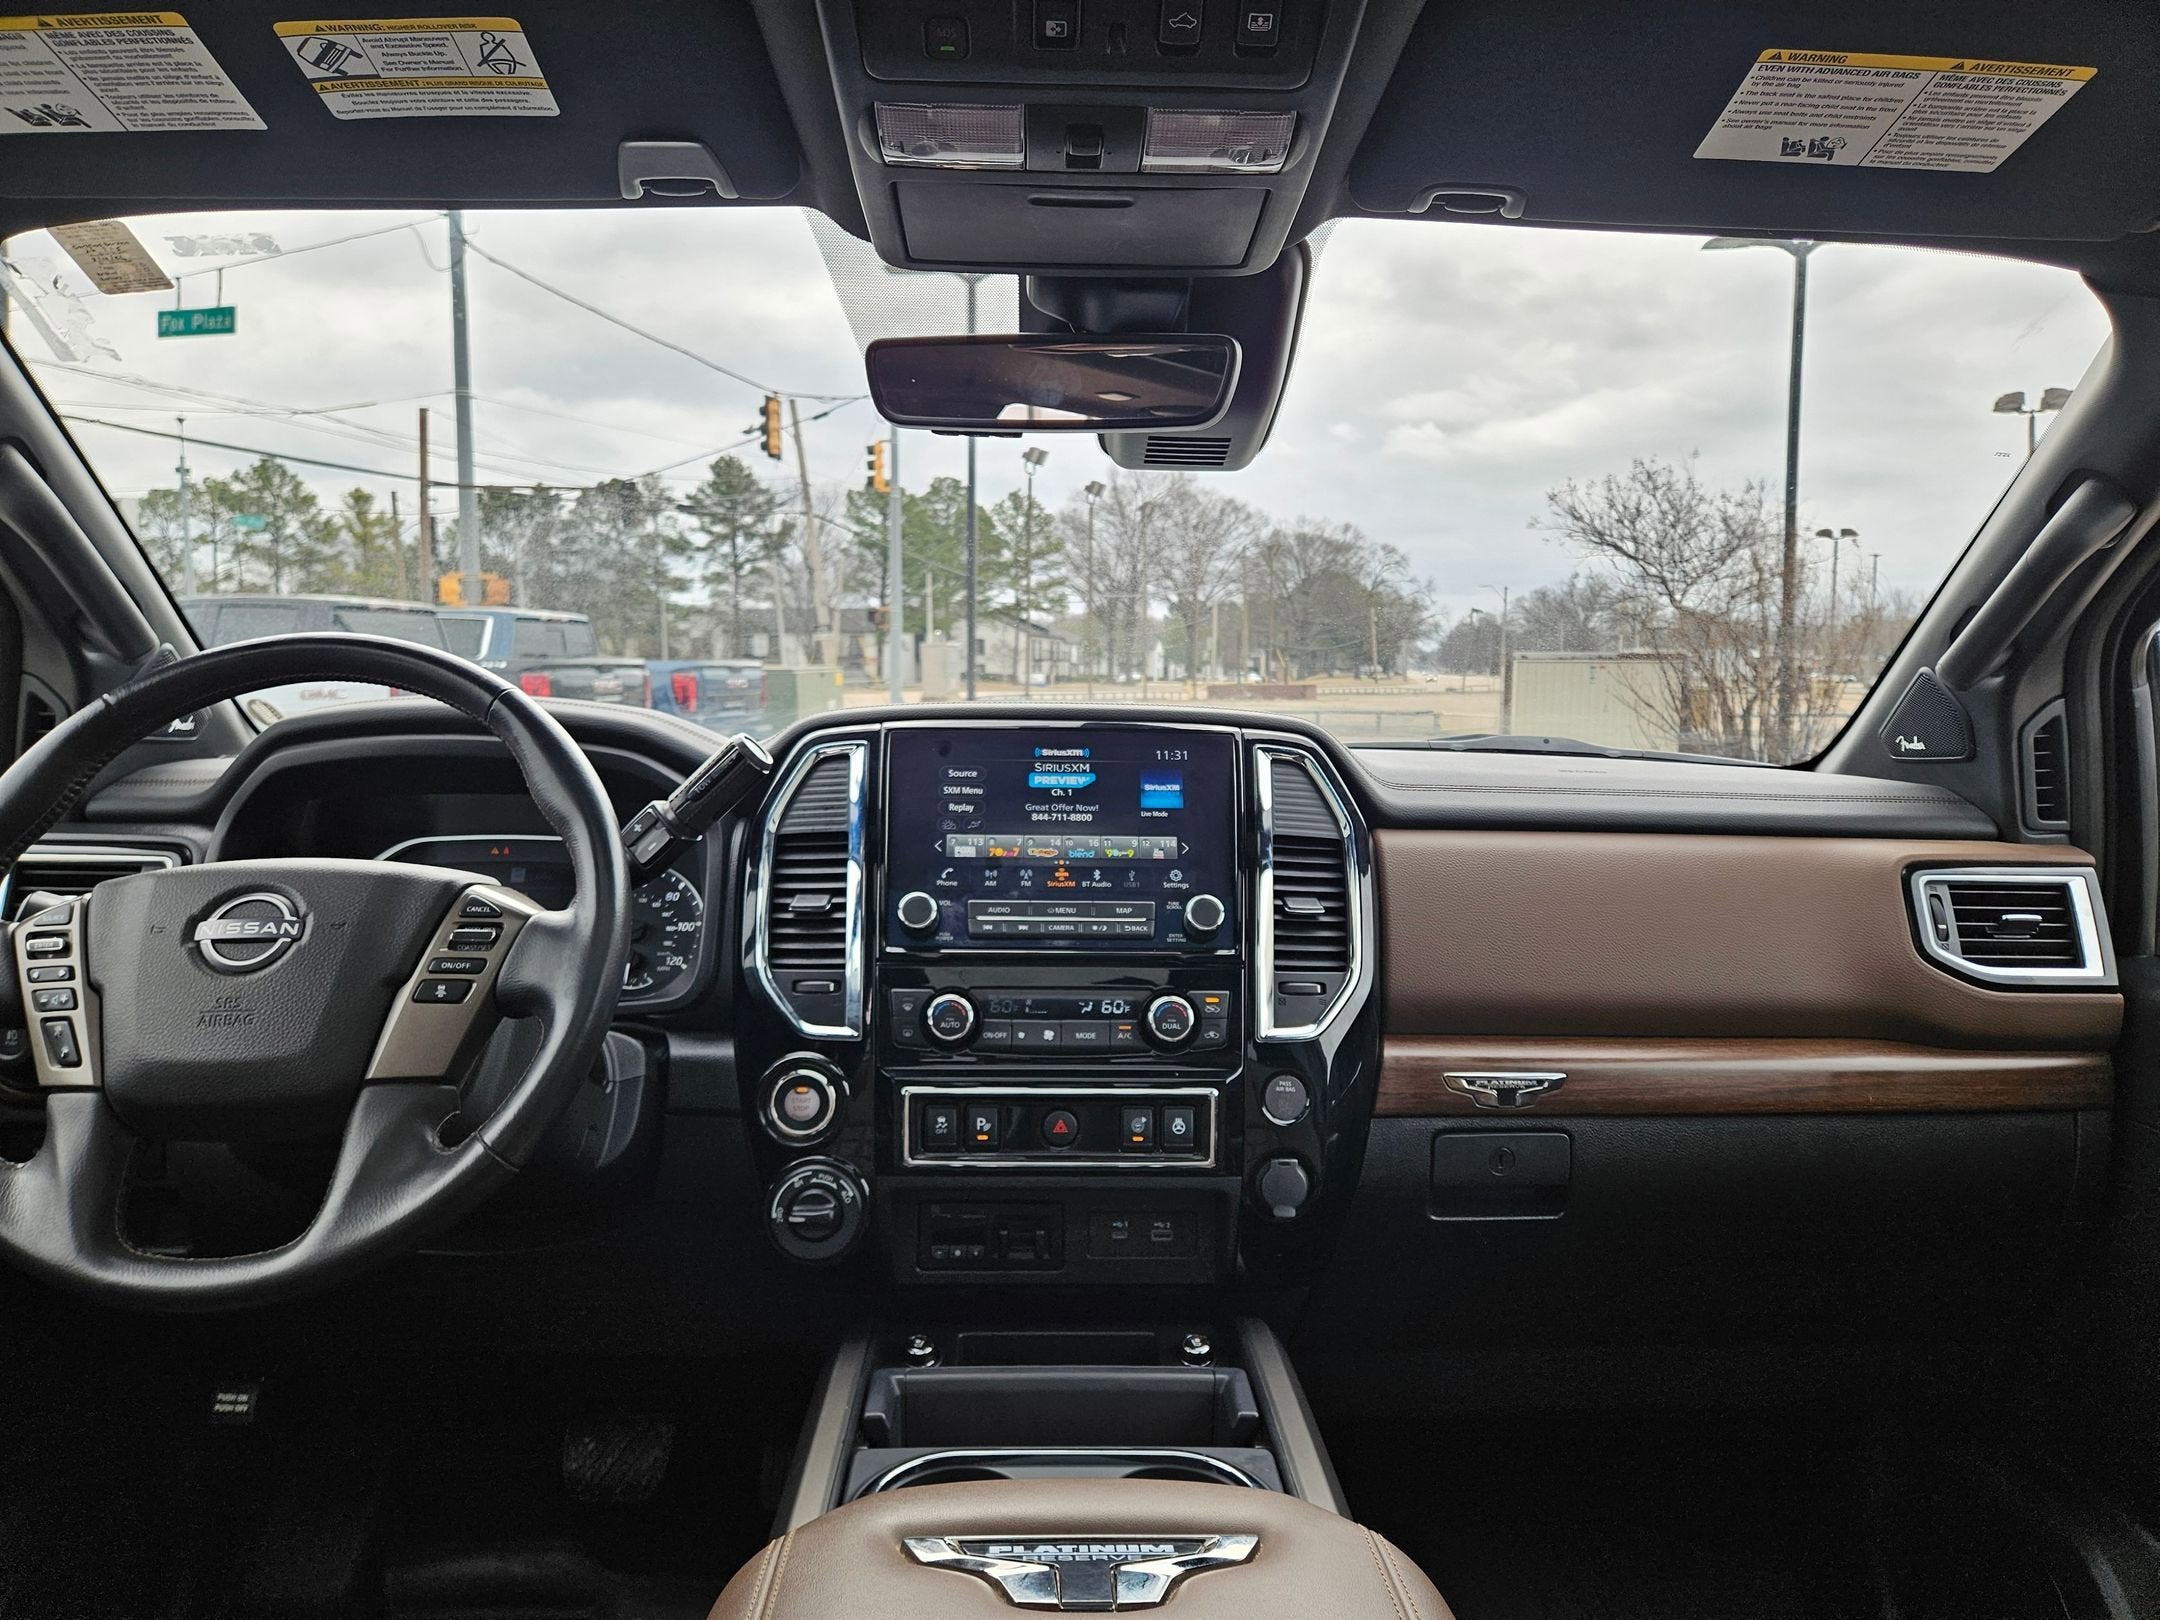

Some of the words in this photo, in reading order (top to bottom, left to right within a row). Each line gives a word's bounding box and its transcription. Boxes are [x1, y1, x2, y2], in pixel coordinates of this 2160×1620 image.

[56, 15, 165, 27] AVERTISSEMENT
[325, 24, 385, 32] WARNING:
[104, 30, 125, 38] DES
[127, 29, 175, 37] COUSSINS
[1787, 52, 1848, 64] WARNING
[1758, 64, 1786, 73] EVEN
[1787, 66, 1814, 74] WITH
[1815, 67, 1871, 76] ADVANCED
[1872, 70, 1891, 78] AIR
[1891, 71, 1921, 79] BAGS
[1969, 63, 2075, 77] AVERTISSEMENT
[330, 80, 420, 90] AVERTISSEMENT
[1939, 74, 1970, 82] MÊME
[1969, 75, 1993, 83] AVEC
[1994, 77, 2014, 85] DES
[2015, 79, 2064, 88] COUSSINS
[160, 315, 185, 333] Fox
[191, 313, 232, 330] Plaza
[1156, 750, 1188, 760] 11:31
[1034, 762, 1090, 772] SIRIUSXM
[948, 769, 977, 778] Source
[1034, 775, 1090, 785] PREVIEW
[943, 786, 960, 794] SXM
[961, 786, 983, 795] Menu
[1051, 788, 1065, 796] Ch.
[948, 803, 974, 813] Replay
[1025, 803, 1049, 812] Great
[1051, 803, 1074, 812] Offer
[1076, 803, 1099, 812] Now!
[1031, 813, 1093, 821] 844-711-8800
[968, 838, 984, 846] 113
[1161, 839, 1177, 847] 114
[1047, 880, 1076, 888] SiriusXM
[1163, 881, 1189, 890] Settings
[665, 891, 680, 901] 80
[200, 921, 300, 935] NISSAN
[677, 921, 696, 931] 100
[665, 956, 683, 966] 120
[197, 1013, 255, 1027] AIRBAG
[988, 1543, 1175, 1553] PLATINUM
